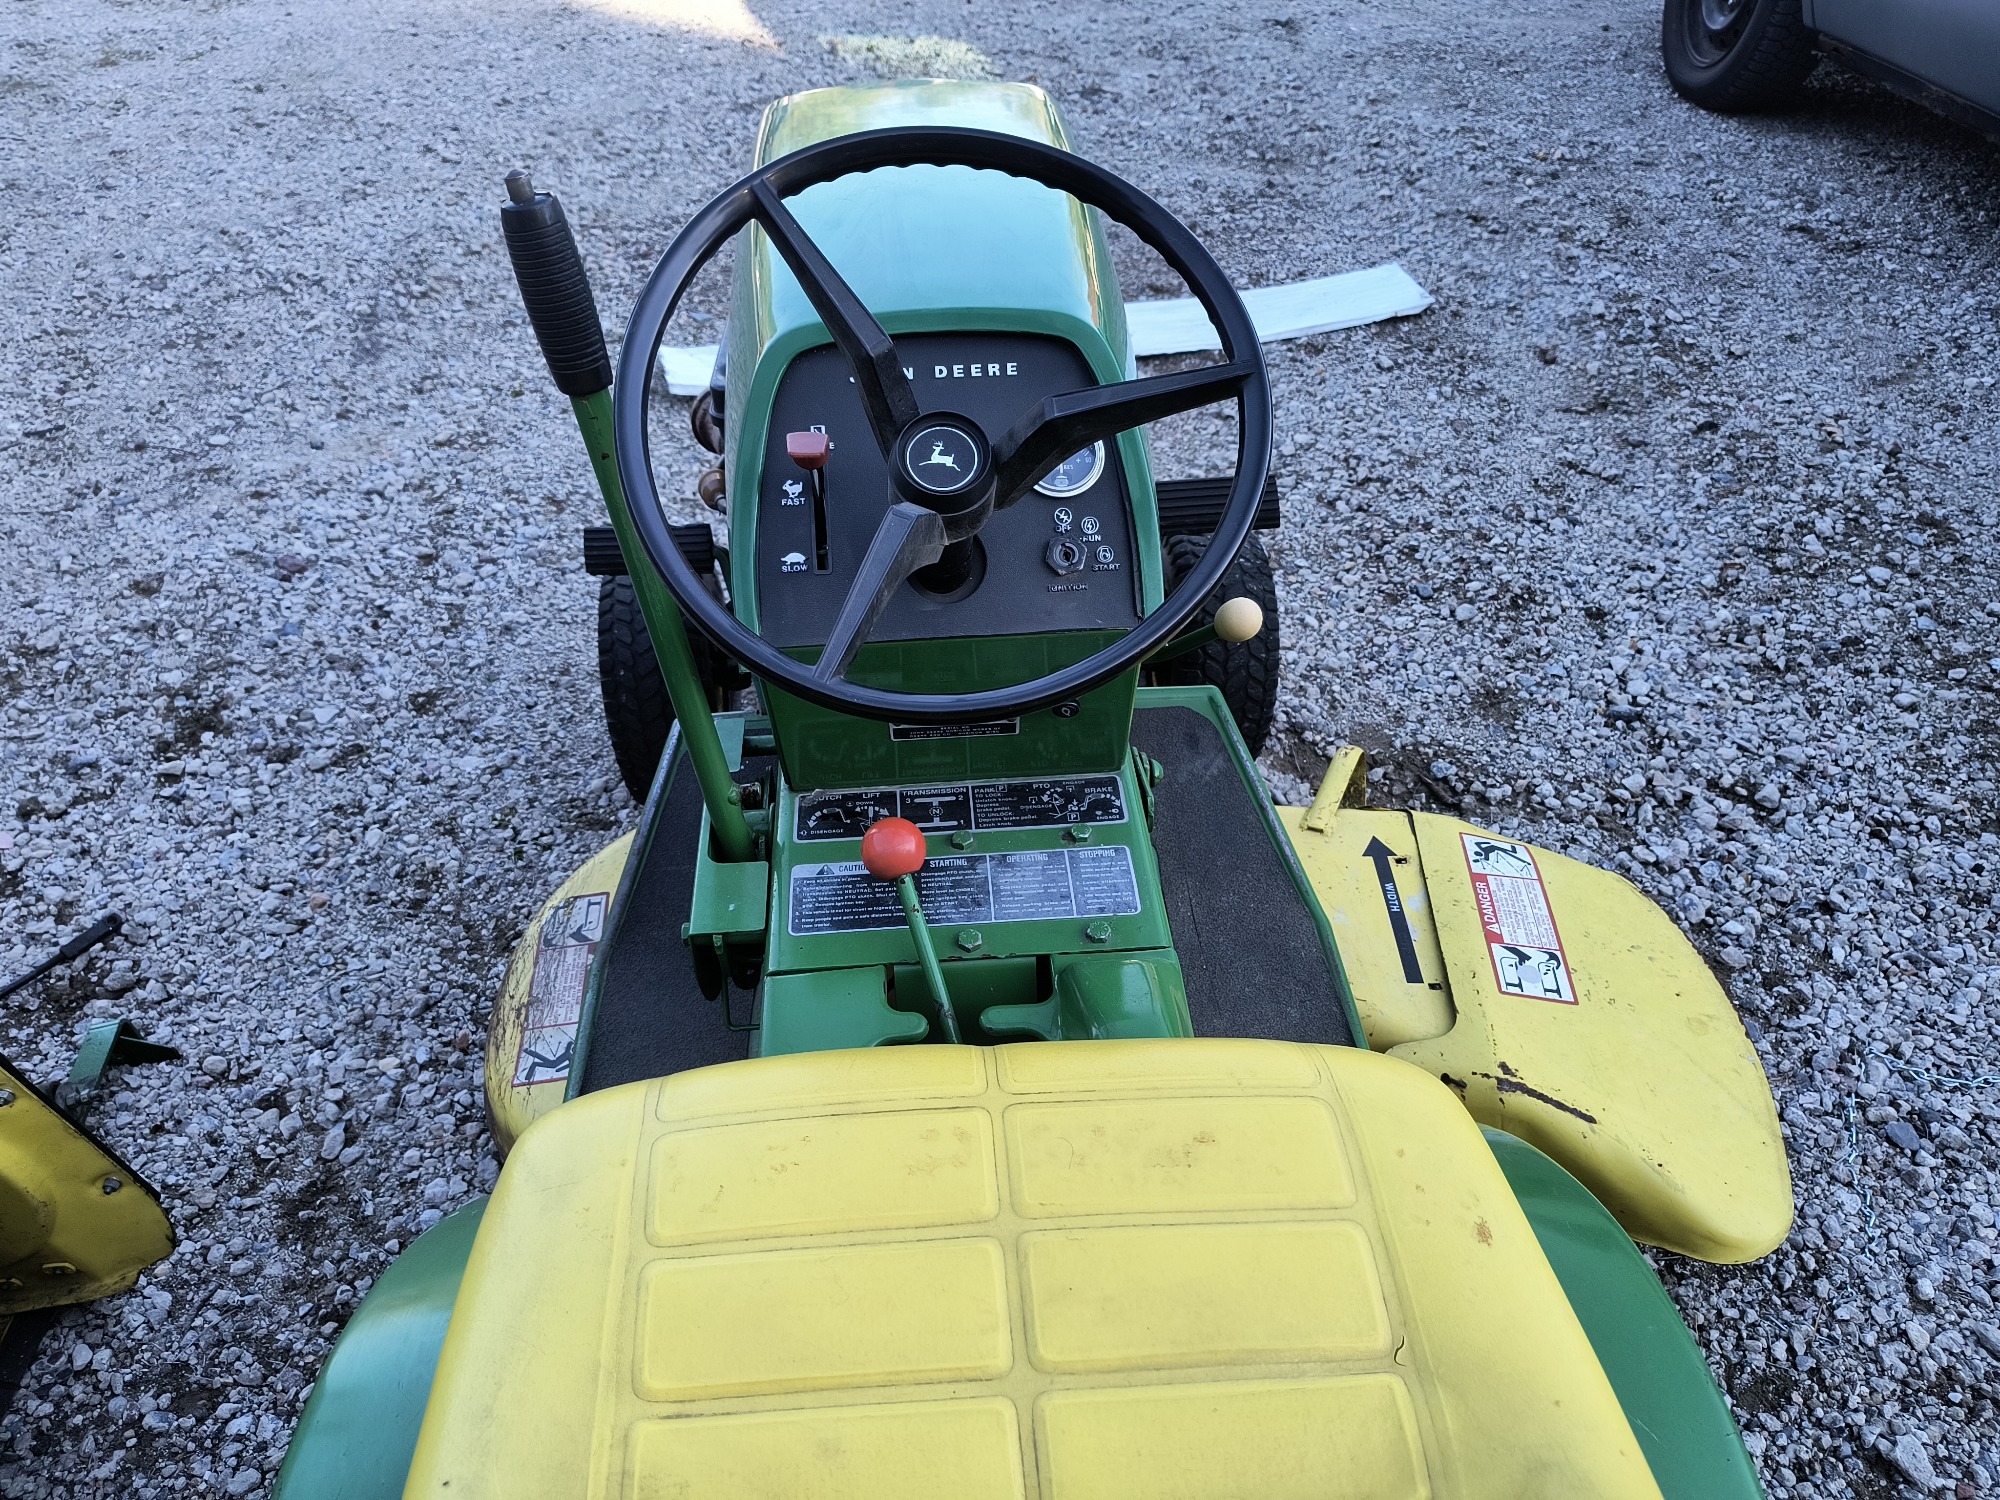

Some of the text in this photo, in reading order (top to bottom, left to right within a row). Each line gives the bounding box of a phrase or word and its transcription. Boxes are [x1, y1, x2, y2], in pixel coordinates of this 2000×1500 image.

[935, 363, 1017, 378] DEERE
[902, 787, 966, 796] TRANSMISSION
[1006, 853, 1048, 862] OPERATING
[1080, 850, 1115, 858] STOPPING
[839, 863, 867, 872] CAUTIO
[930, 859, 967, 867] STARTING
[1385, 883, 1400, 912] WIDTH
[1474, 881, 1496, 922] DANGER
